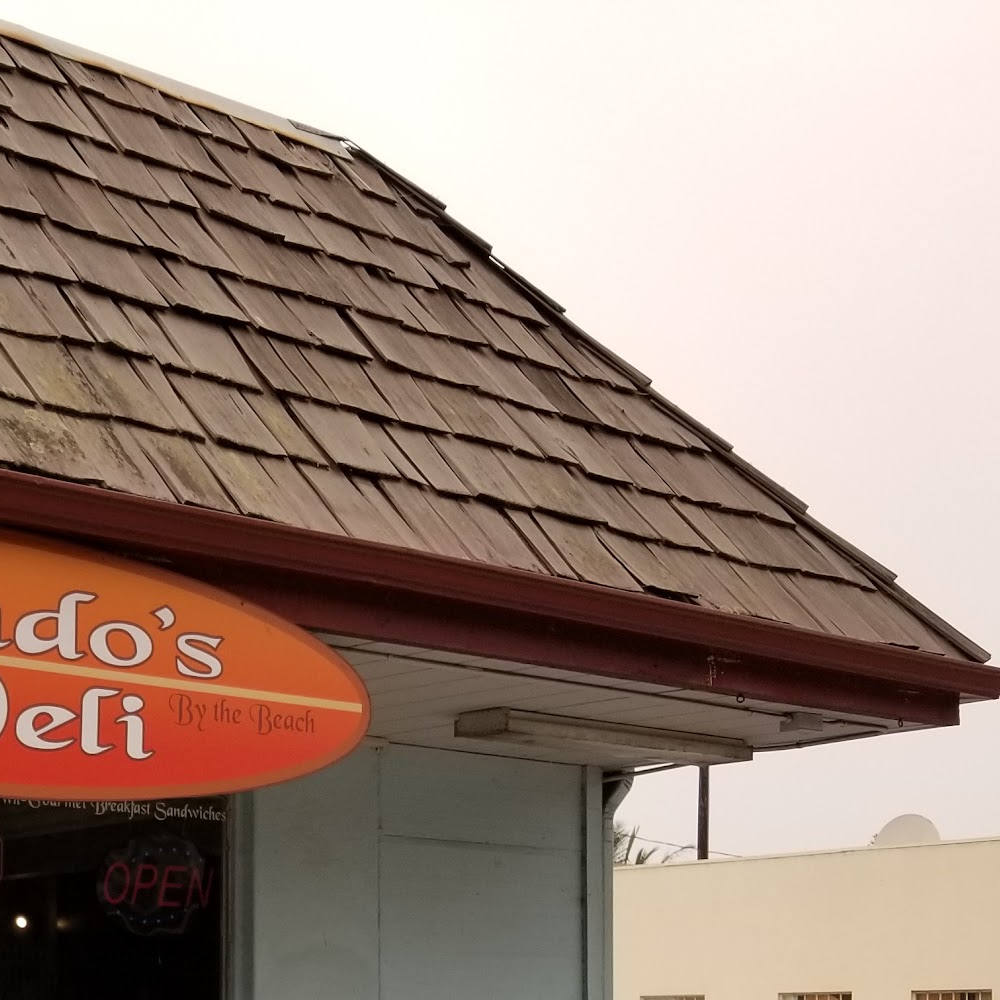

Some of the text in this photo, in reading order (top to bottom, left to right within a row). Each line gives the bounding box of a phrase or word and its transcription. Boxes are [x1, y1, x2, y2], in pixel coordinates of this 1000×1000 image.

[168, 693, 316, 735] By the Beach
[90, 801, 151, 820] Breakfast
[153, 802, 227, 821] Sandwiches
[103, 863, 214, 909] OPEN
